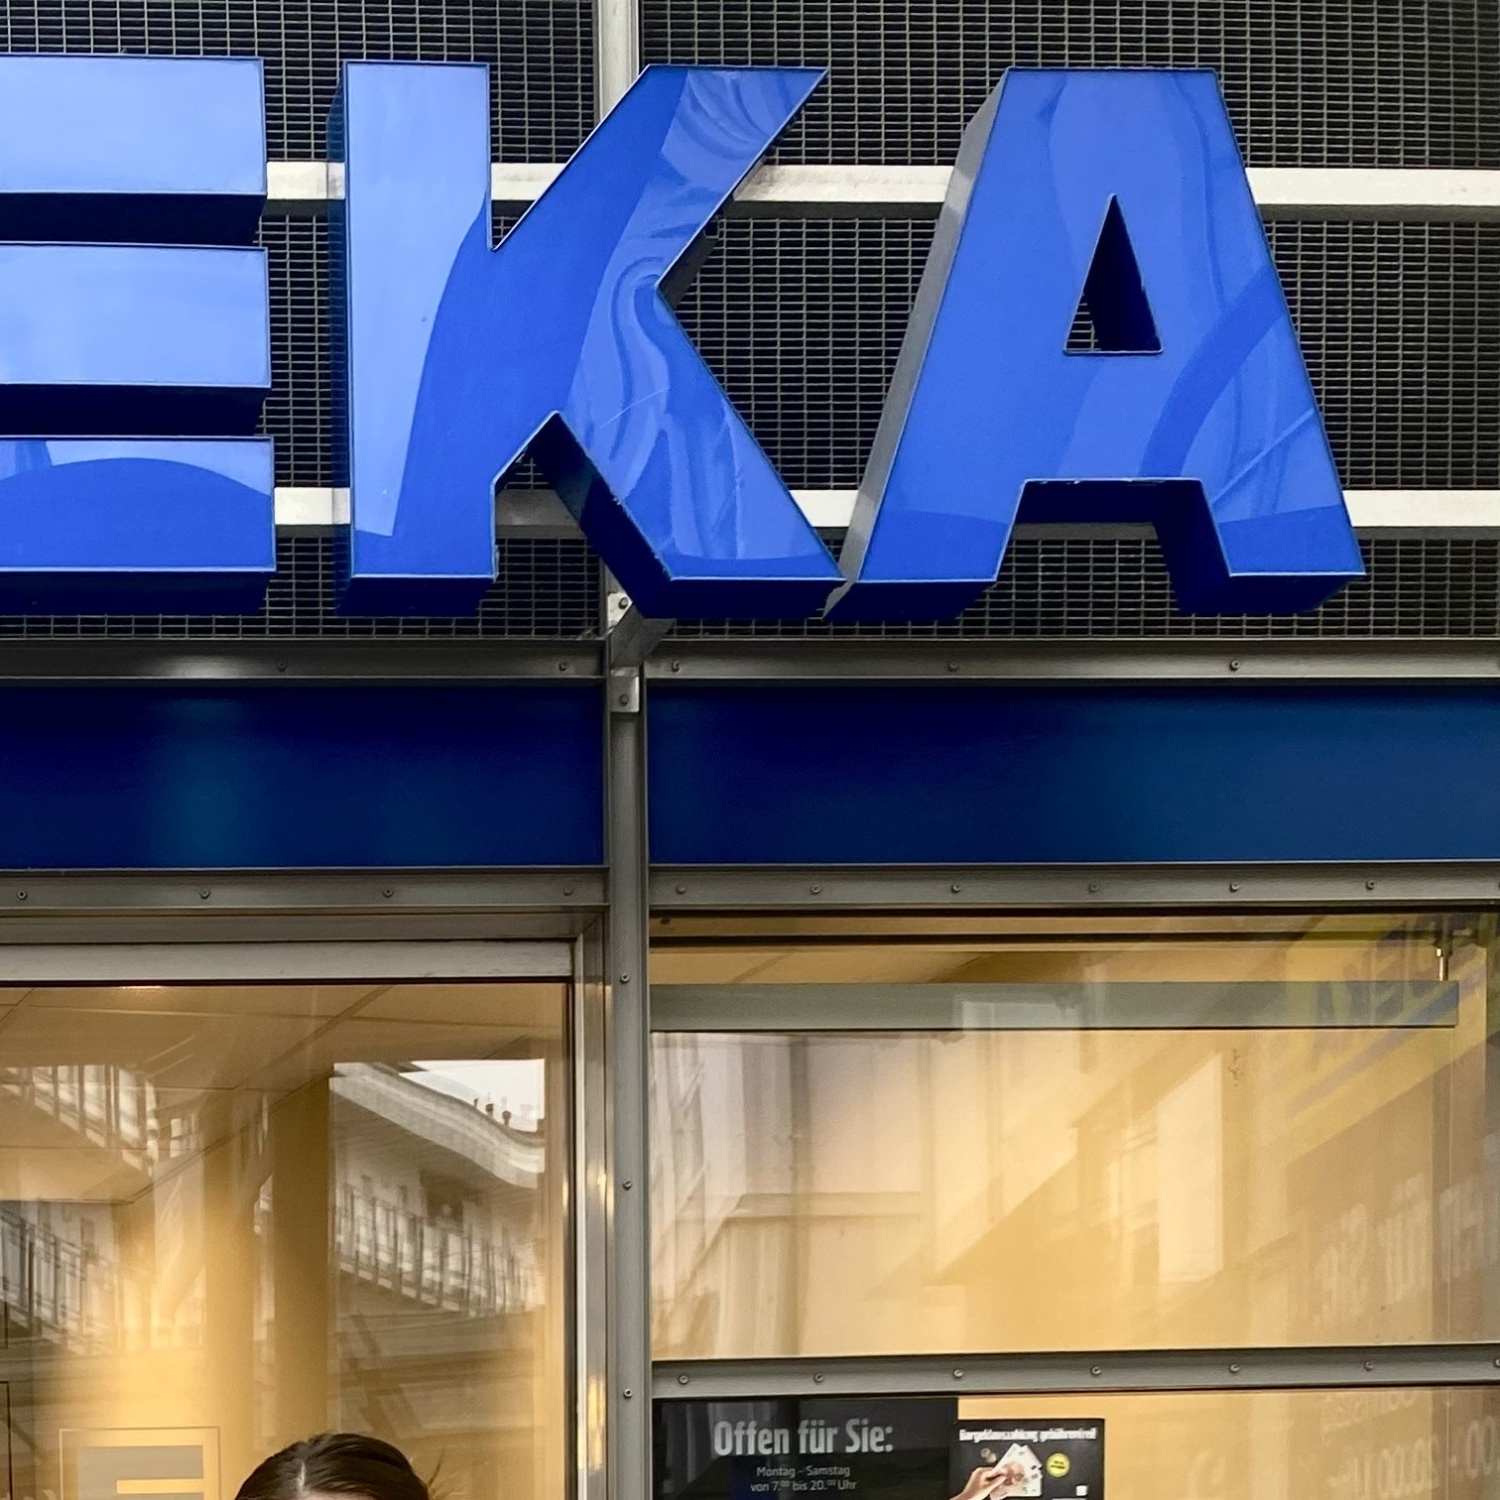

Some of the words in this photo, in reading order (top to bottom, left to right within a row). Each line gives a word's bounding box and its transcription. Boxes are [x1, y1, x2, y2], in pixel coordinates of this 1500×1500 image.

[713, 1420, 790, 1456] Offen
[798, 1420, 839, 1454] für
[845, 1418, 893, 1453] Sie:
[756, 1466, 795, 1478] Montag
[806, 1465, 850, 1477] Samstag
[751, 1484, 769, 1492] von
[792, 1481, 807, 1491] bis
[838, 1480, 857, 1490] Uhr
